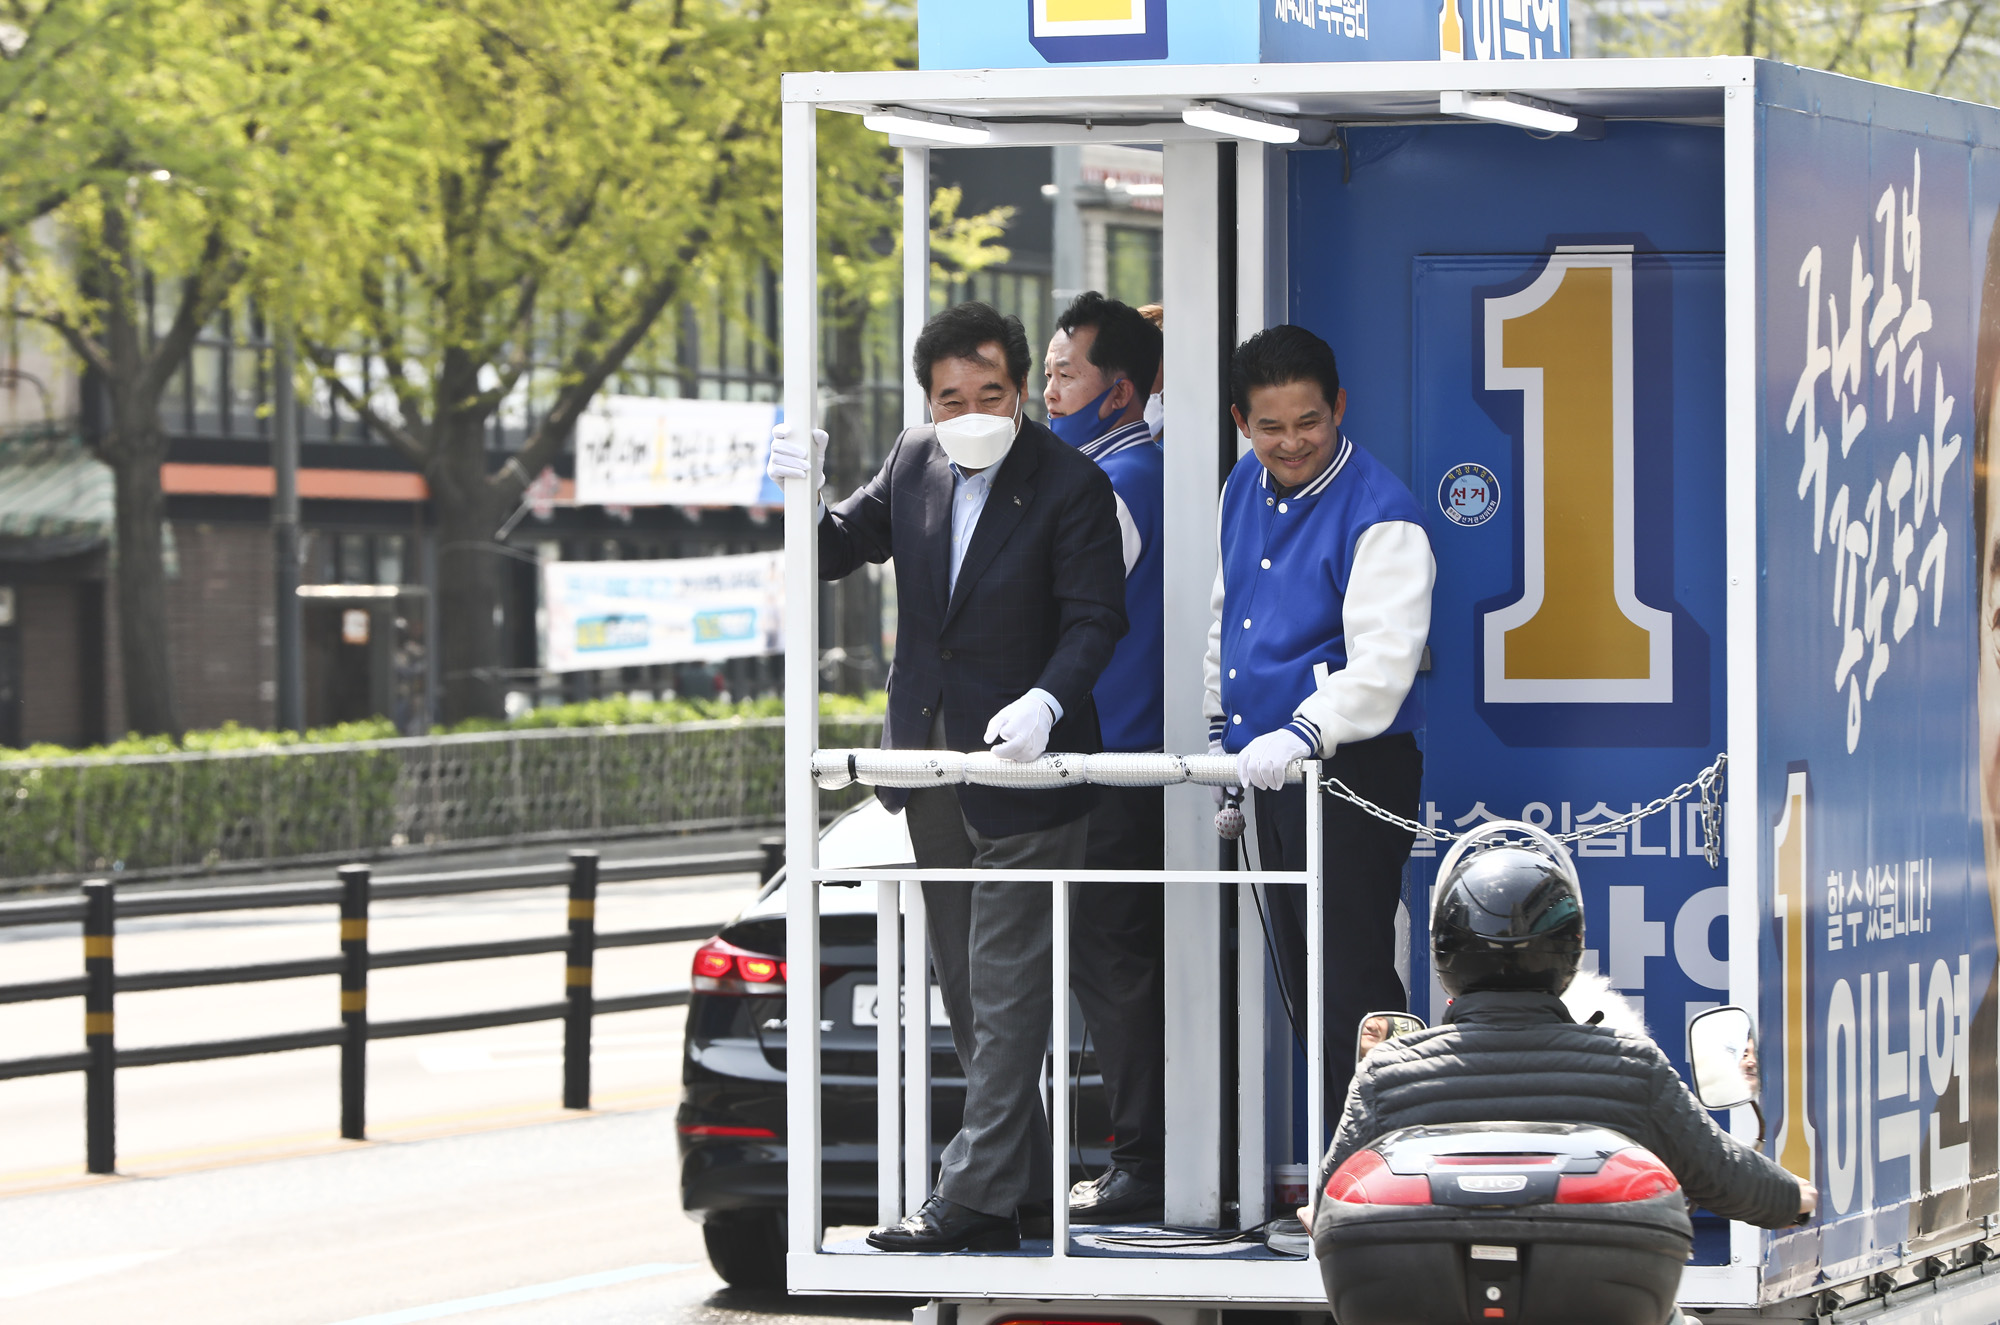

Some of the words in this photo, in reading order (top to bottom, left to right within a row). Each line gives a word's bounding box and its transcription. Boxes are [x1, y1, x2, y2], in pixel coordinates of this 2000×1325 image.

[1451, 487, 1485, 506] 선거
[1484, 245, 1673, 703] 1
[1827, 870, 1845, 952] 할
[1846, 869, 1863, 947] 수
[1865, 857, 1933, 943] 있습니다!
[1826, 954, 1970, 1216] 이낙연
